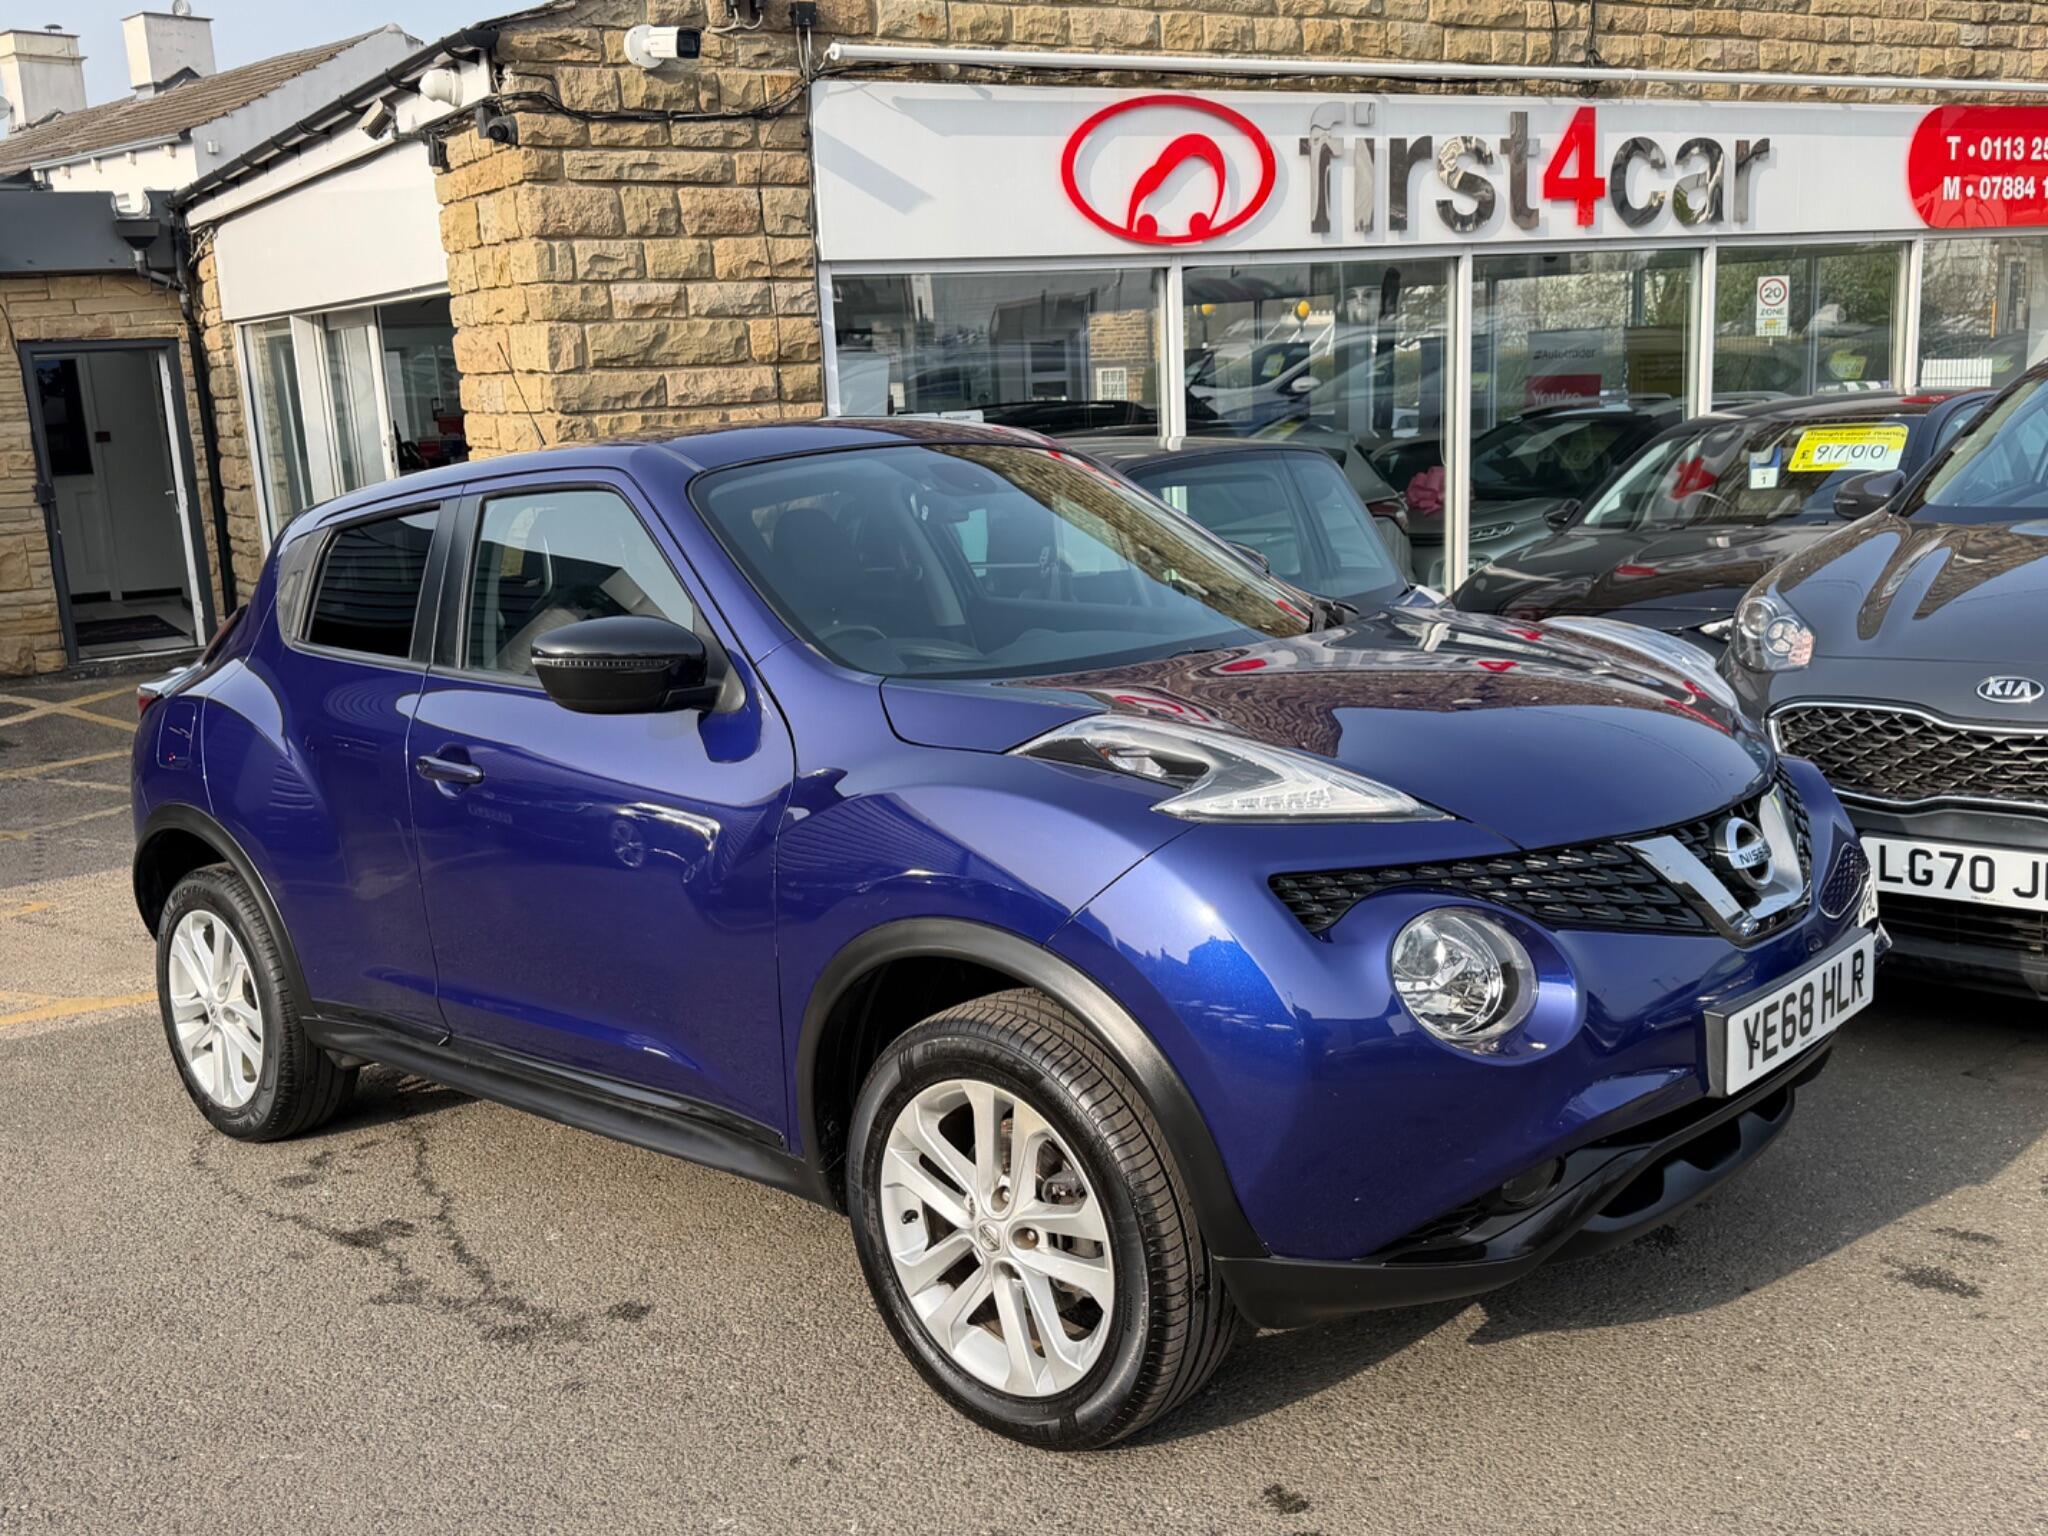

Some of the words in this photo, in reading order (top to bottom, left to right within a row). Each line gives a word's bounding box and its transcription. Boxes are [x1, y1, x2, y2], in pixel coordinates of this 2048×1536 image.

[1979, 136, 2025, 161] 0113
[1298, 101, 1770, 234] first4car
[1979, 175, 2036, 201] 07884
[1764, 287, 1782, 298] 20
[1760, 307, 1785, 316] ZONE
[1817, 444, 1885, 460] 9700
[1986, 680, 2032, 697] KIA
[1878, 844, 1996, 894] LG70
[2012, 860, 2048, 900] J
[1742, 981, 1815, 1071] YE68
[1821, 949, 1864, 1025] HLR
